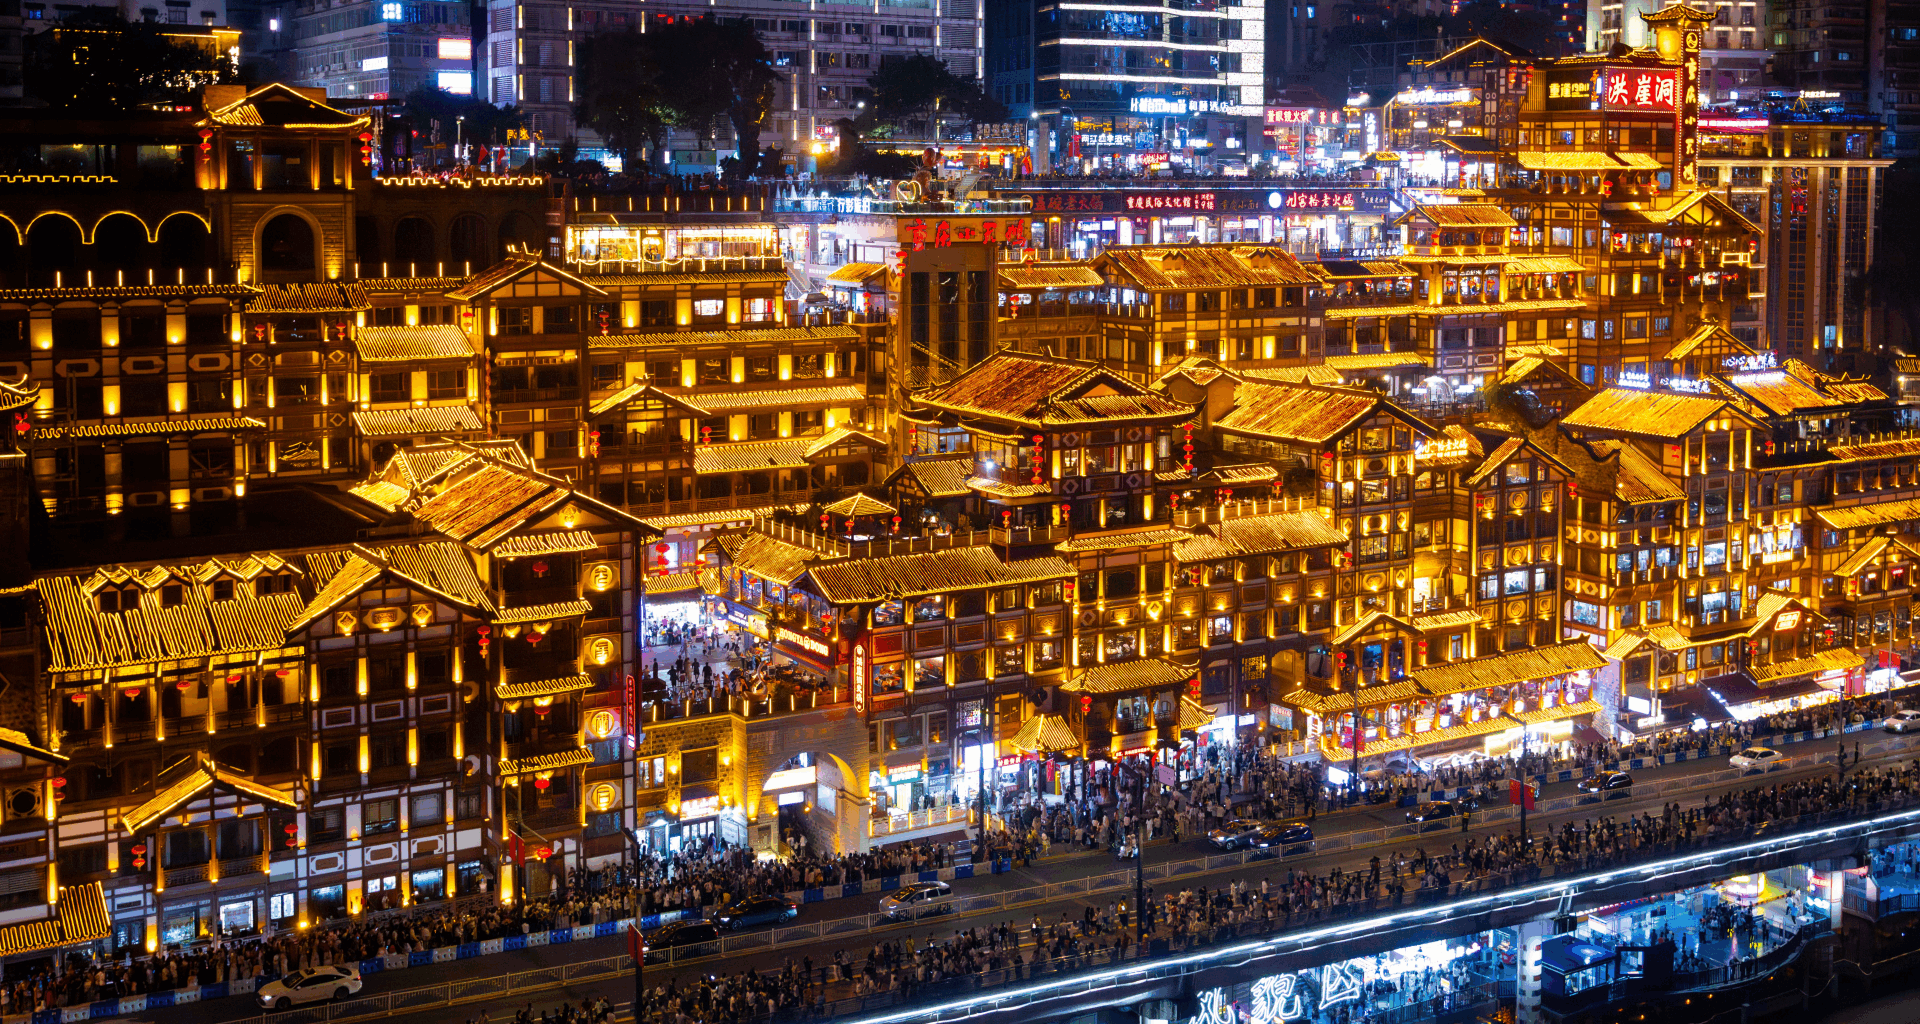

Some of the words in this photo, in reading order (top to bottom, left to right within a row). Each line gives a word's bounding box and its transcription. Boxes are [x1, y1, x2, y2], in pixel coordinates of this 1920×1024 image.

[1608, 72, 1675, 107] 洪崖洞
[1285, 191, 1355, 208] 九宫格老火锅
[906, 218, 1026, 251] 重庆小天鹅
[779, 627, 804, 646] HONGYA
[810, 638, 829, 657] DONG
